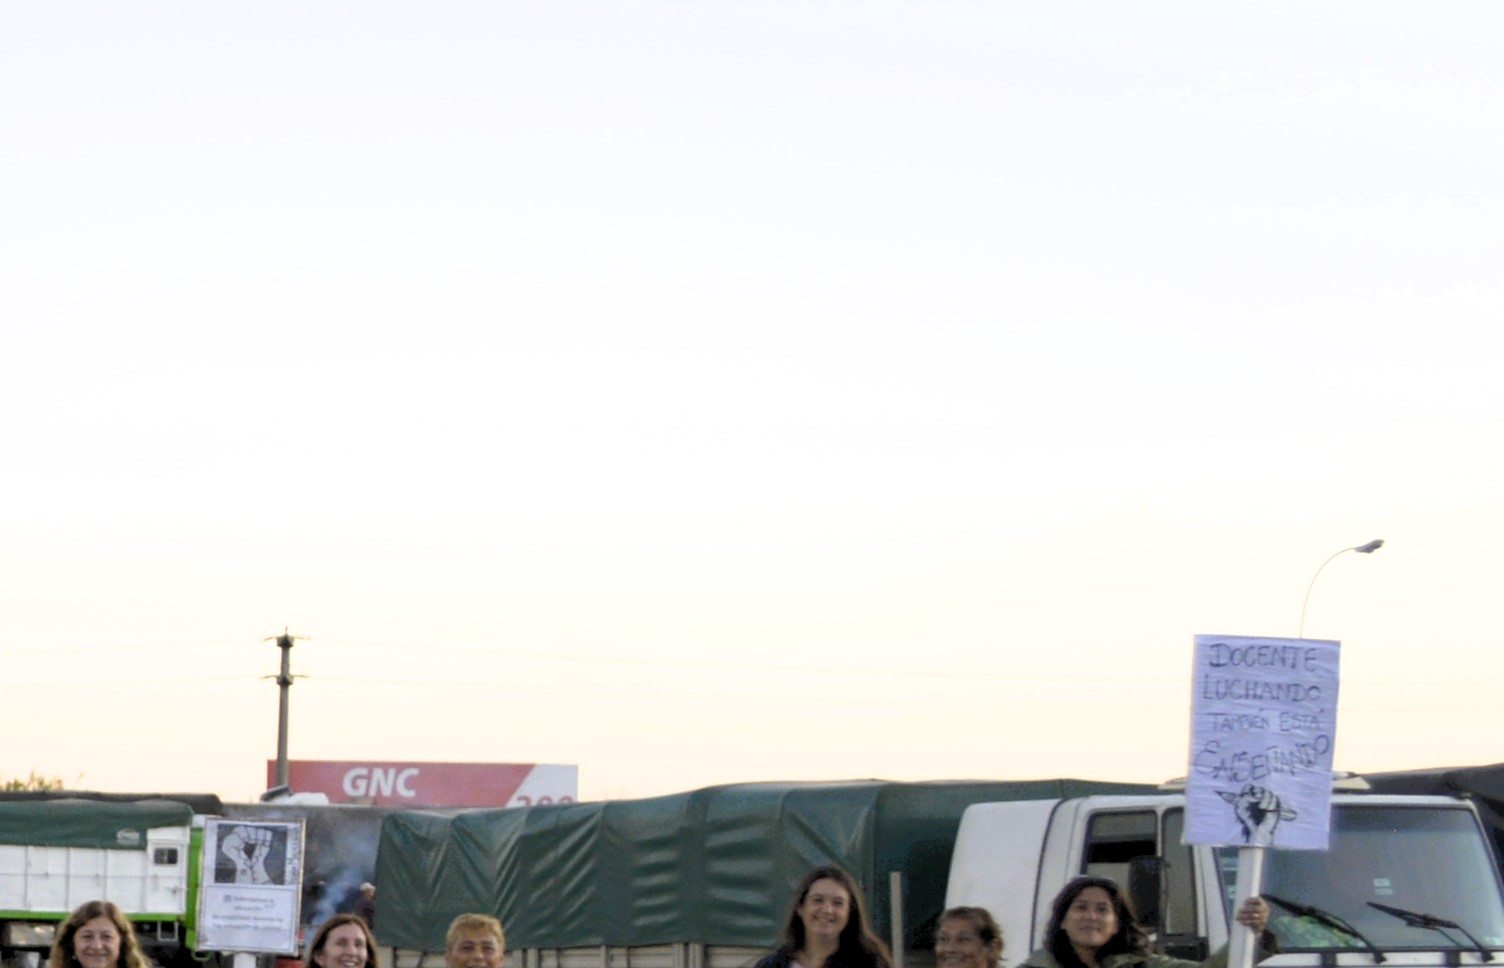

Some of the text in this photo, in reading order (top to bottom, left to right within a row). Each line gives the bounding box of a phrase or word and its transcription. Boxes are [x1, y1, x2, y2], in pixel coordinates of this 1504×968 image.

[1209, 643, 1317, 672] DOCENTE
[1203, 674, 1322, 702] LUCHANDO
[343, 767, 419, 797] GNC
